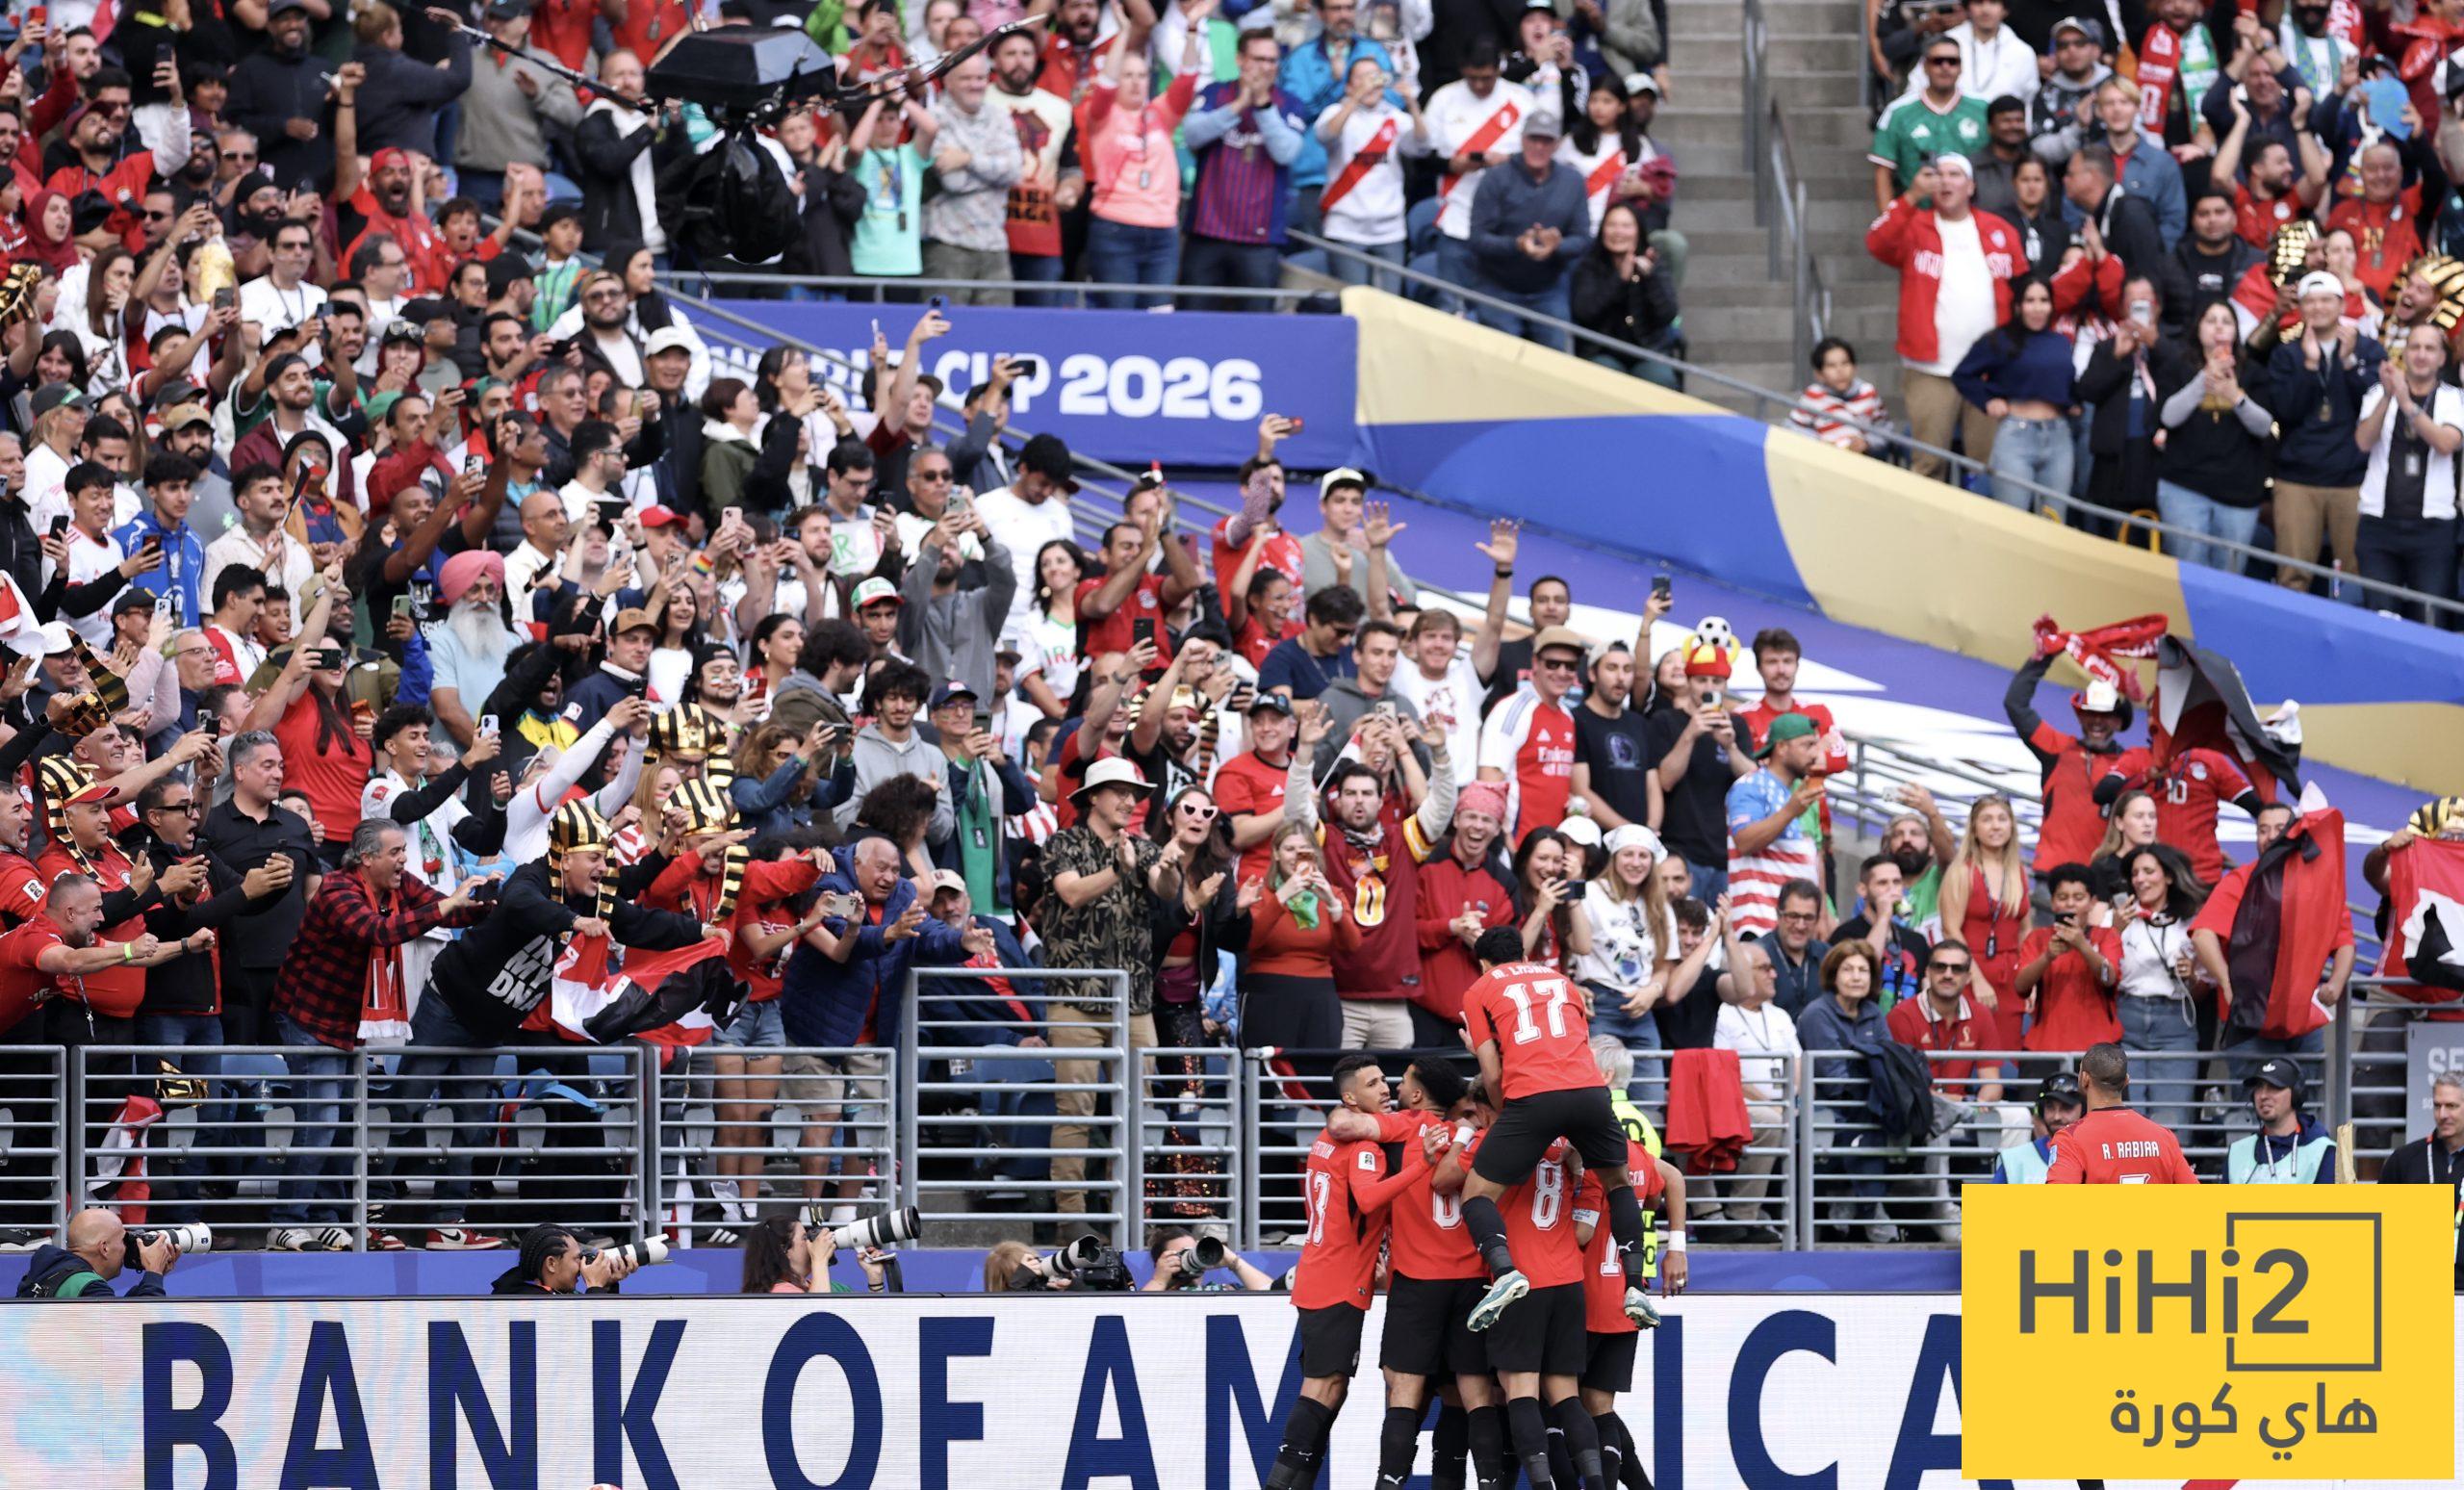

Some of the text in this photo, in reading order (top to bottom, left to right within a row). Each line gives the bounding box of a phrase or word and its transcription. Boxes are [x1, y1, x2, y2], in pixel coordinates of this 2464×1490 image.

[707, 346, 924, 411] WRL
[1059, 353, 1263, 421] 2026
[2168, 778, 2187, 805] 10
[503, 949, 554, 989] MY
[523, 934, 554, 966] IN
[486, 968, 545, 1012] DNA
[1502, 978, 1567, 1045] 17
[2101, 1141, 2160, 1160] R. RABIAA
[1305, 1169, 1331, 1247] 13
[1530, 1158, 1563, 1231] 8
[141, 1308, 2016, 1490] BANK OF AMICA
